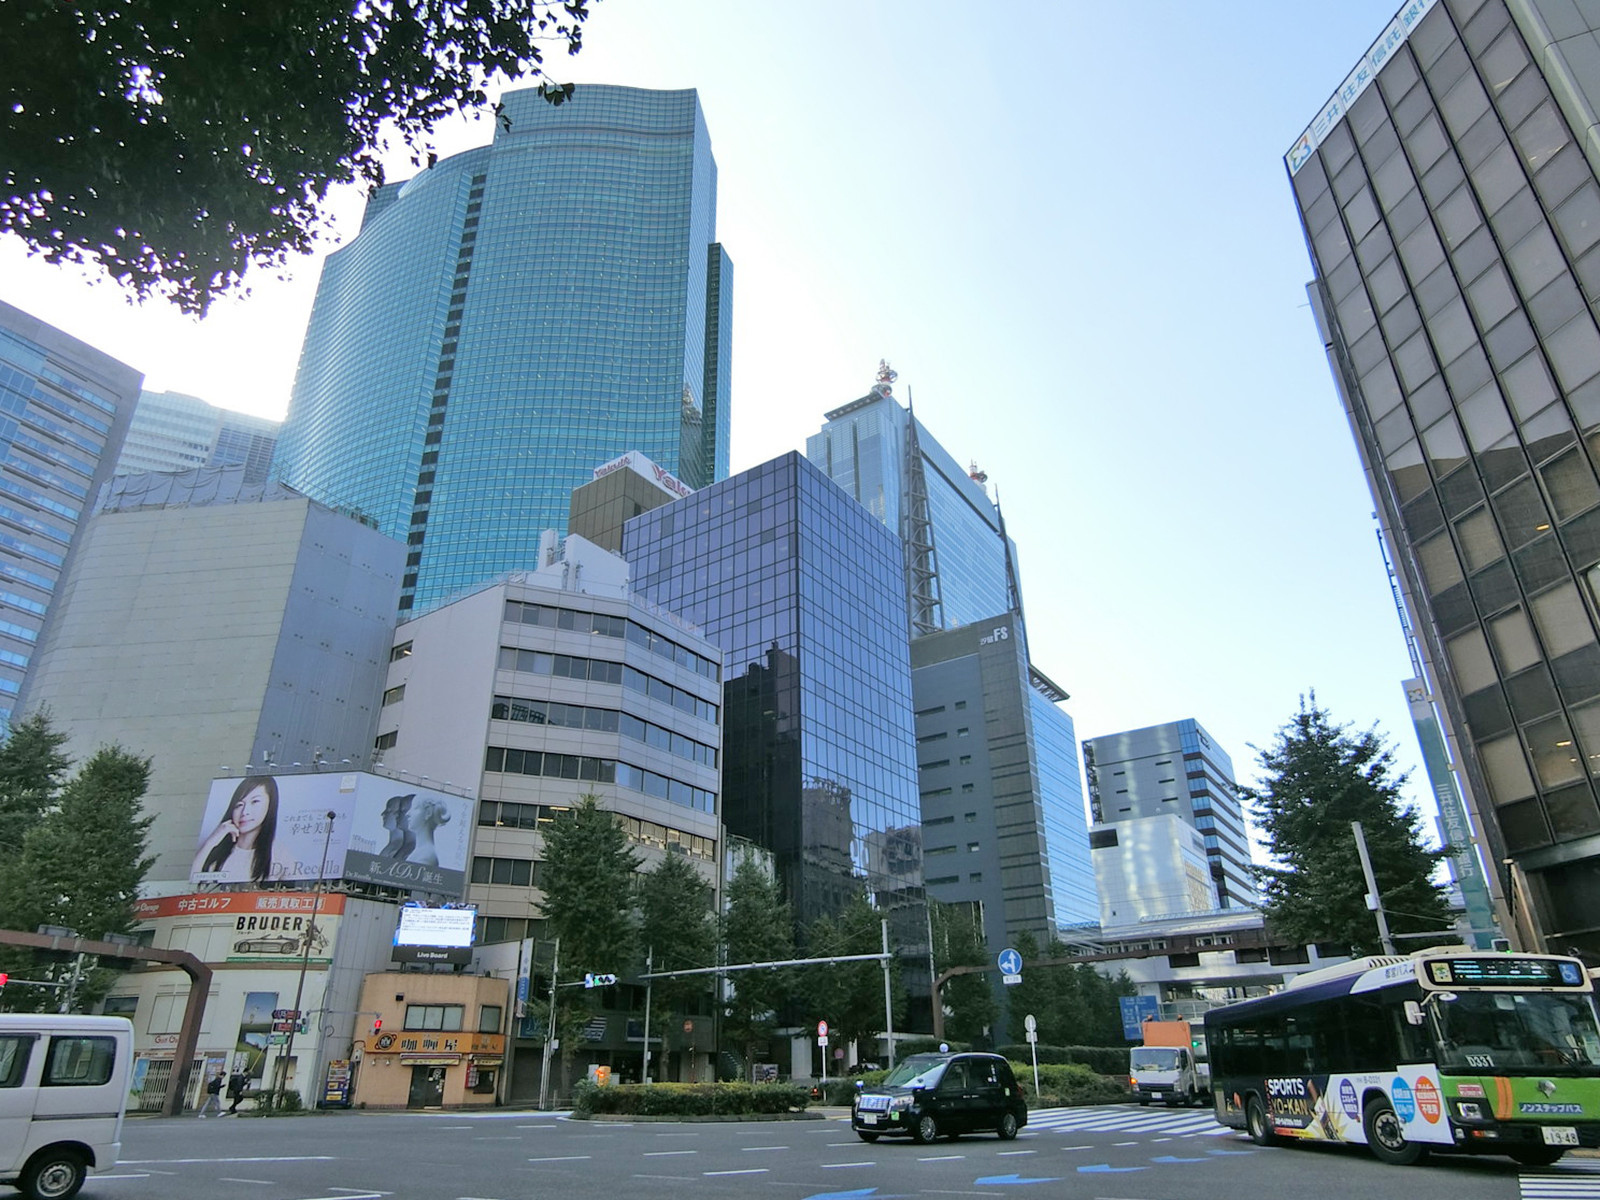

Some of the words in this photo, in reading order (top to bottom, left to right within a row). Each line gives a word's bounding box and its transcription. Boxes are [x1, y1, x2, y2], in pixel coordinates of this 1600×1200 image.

[1315, 0, 1432, 139] 三井住友信託銀
[178, 897, 231, 911] 中古ゴルフ
[236, 916, 303, 931] BRUDER
[1467, 1055, 1494, 1067] D331
[1267, 1078, 1306, 1096] SPORTS
[1520, 1103, 1583, 1113] ノンステップバス
